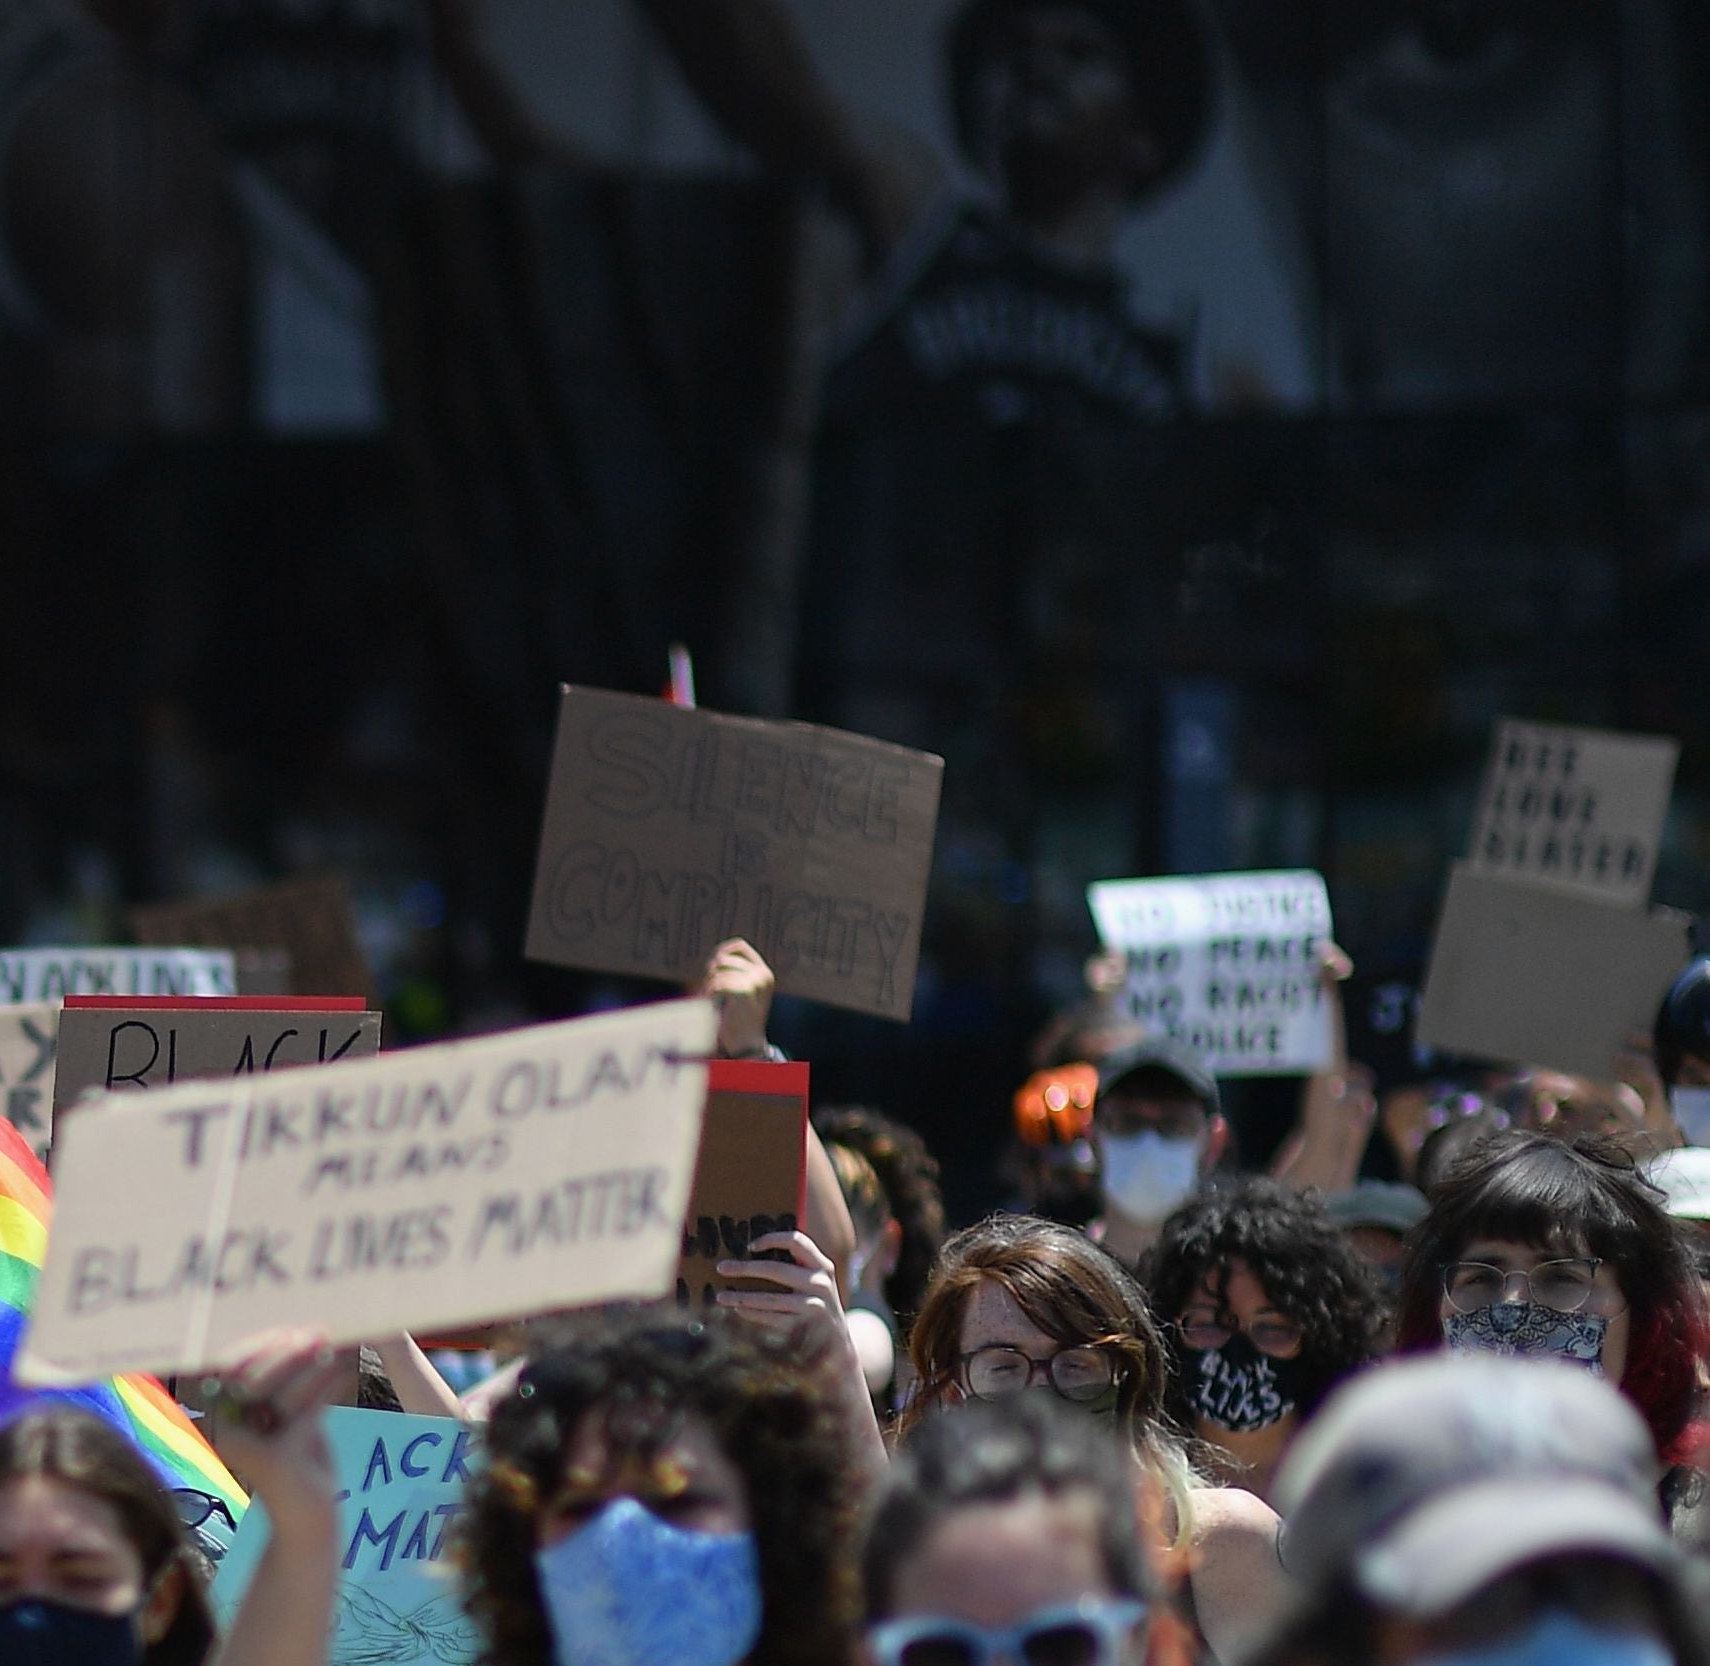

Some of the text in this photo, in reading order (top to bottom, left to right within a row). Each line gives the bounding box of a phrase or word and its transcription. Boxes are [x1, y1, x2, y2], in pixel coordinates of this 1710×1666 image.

[586, 710, 910, 844] SILENCE
[547, 840, 910, 1006] COMPLICITY
[165, 1040, 680, 1168] TIKKUN OLAM
[303, 1135, 511, 1196] MEANS
[70, 1225, 293, 1316] BLACK
[309, 1203, 453, 1283] LIVES
[469, 1167, 672, 1258] MATTER
[335, 1431, 472, 1503] ACK
[342, 1502, 467, 1573] MAT
